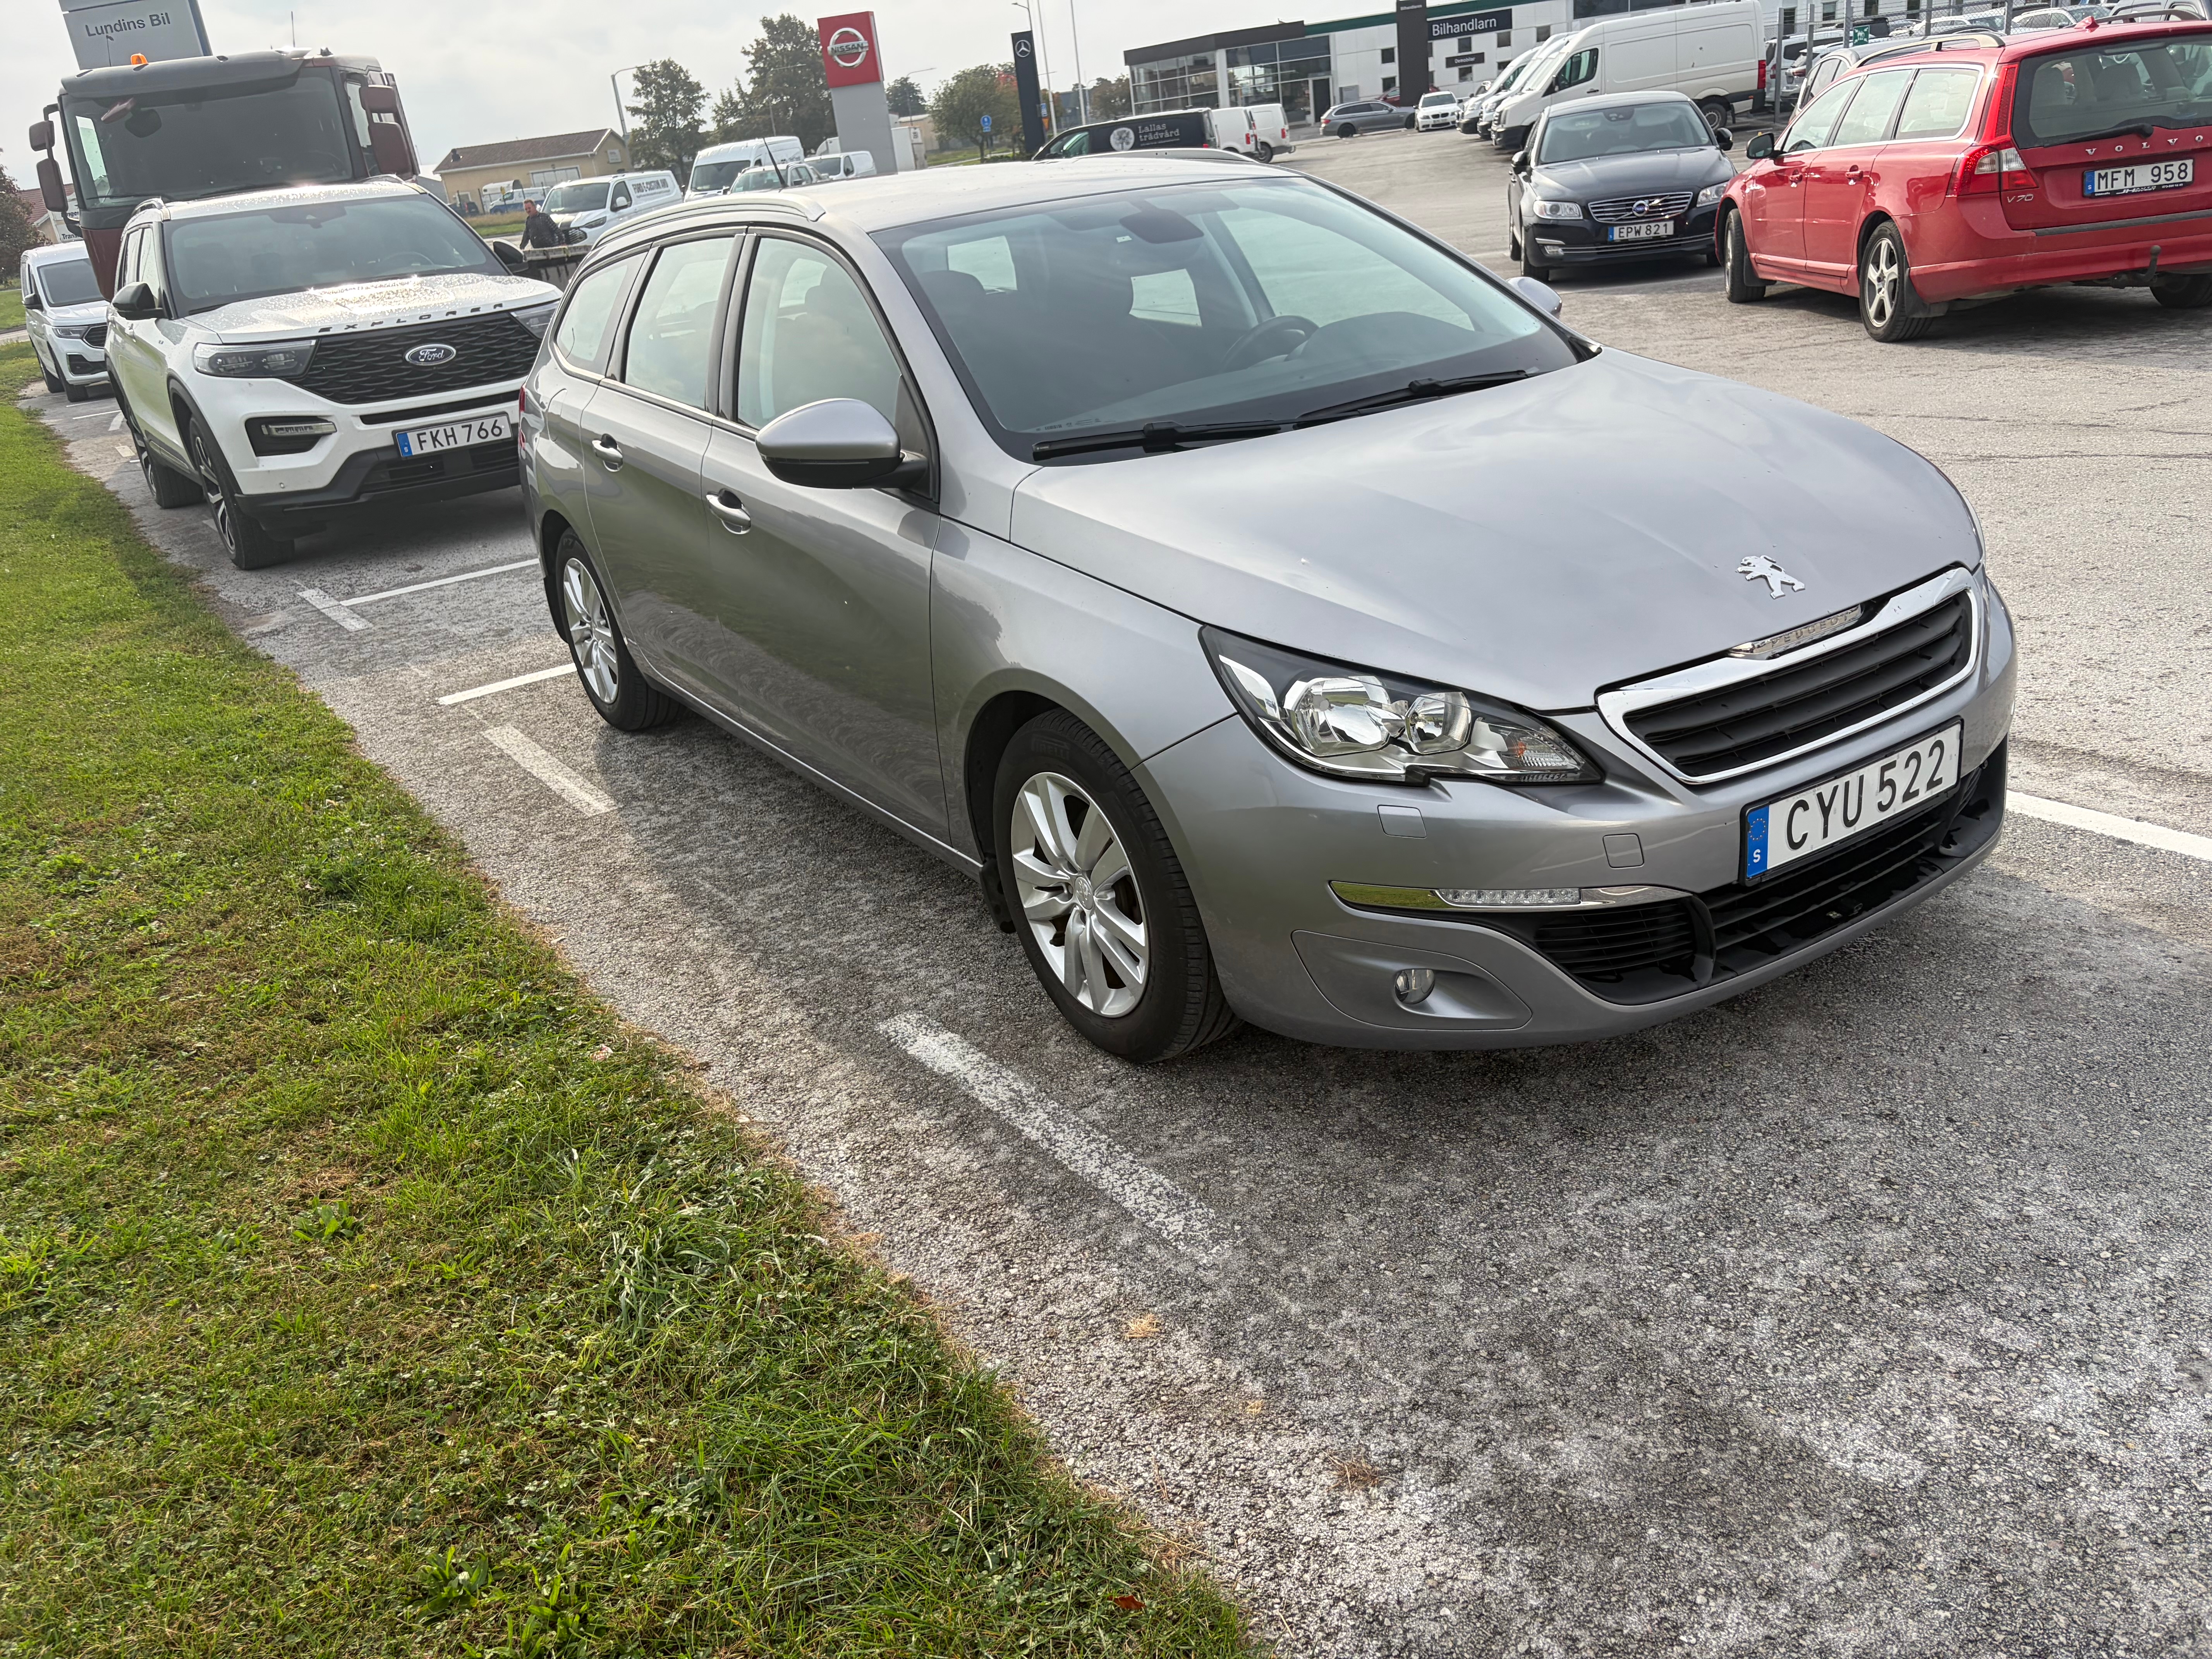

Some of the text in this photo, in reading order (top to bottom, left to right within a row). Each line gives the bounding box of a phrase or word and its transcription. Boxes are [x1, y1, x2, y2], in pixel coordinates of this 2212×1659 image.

[85, 12, 170, 36] Lundins Bil
[1432, 18, 1497, 36] Bilhandlarn
[831, 43, 864, 53] NISSAN
[1139, 124, 1166, 133] Lallas
[2085, 135, 2203, 155] VOLVO
[2098, 163, 2188, 190] MFM 958
[2007, 194, 2033, 203] V70
[1618, 223, 1667, 238] EPW 821
[318, 303, 503, 333] EXPLORER
[419, 348, 445, 362] Ford
[417, 419, 502, 450] FKH 766
[1772, 614, 1848, 647] PEUGEOT
[1031, 734, 1070, 761] PIRELLI
[1786, 740, 1945, 850] CYU 522
[1753, 849, 1761, 863] S
